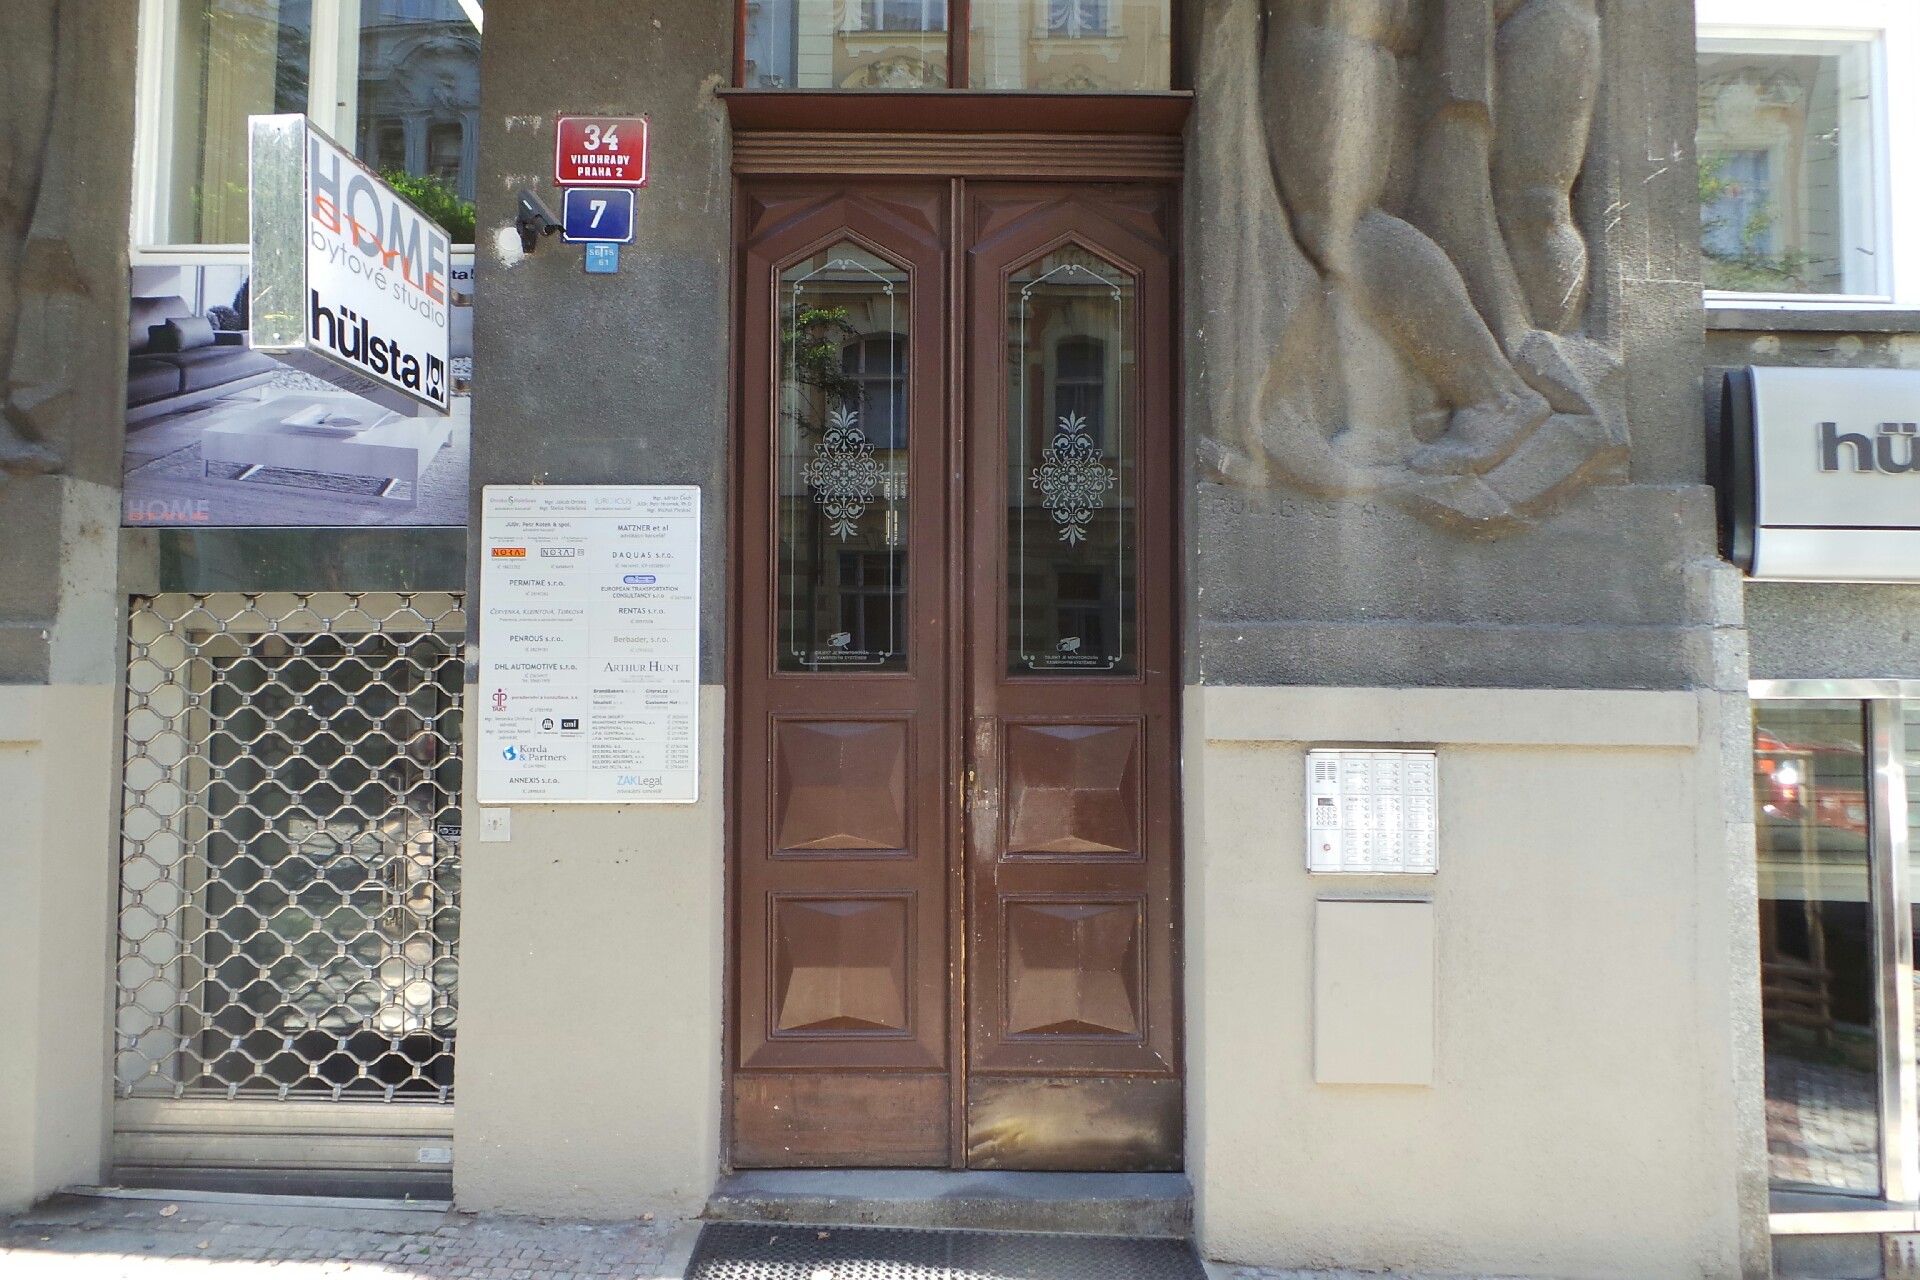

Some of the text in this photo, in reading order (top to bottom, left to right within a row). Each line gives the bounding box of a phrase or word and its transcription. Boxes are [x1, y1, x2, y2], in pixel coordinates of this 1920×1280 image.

[584, 124, 619, 151] 34
[571, 154, 630, 165] VINOHRADY
[577, 166, 623, 177] PRAHA 2
[311, 137, 444, 291] HOME
[590, 200, 607, 229] 7
[311, 194, 445, 306] STYLE
[311, 221, 446, 329] bytové studio
[311, 288, 421, 392] hülsta
[612, 551, 652, 559] DAQUAS
[509, 579, 545, 587] PERMITME
[613, 636, 649, 644] Berbader,
[494, 663, 509, 671] DHL
[510, 663, 558, 671] AUTOMOTIVE
[519, 744, 547, 753] Korda
